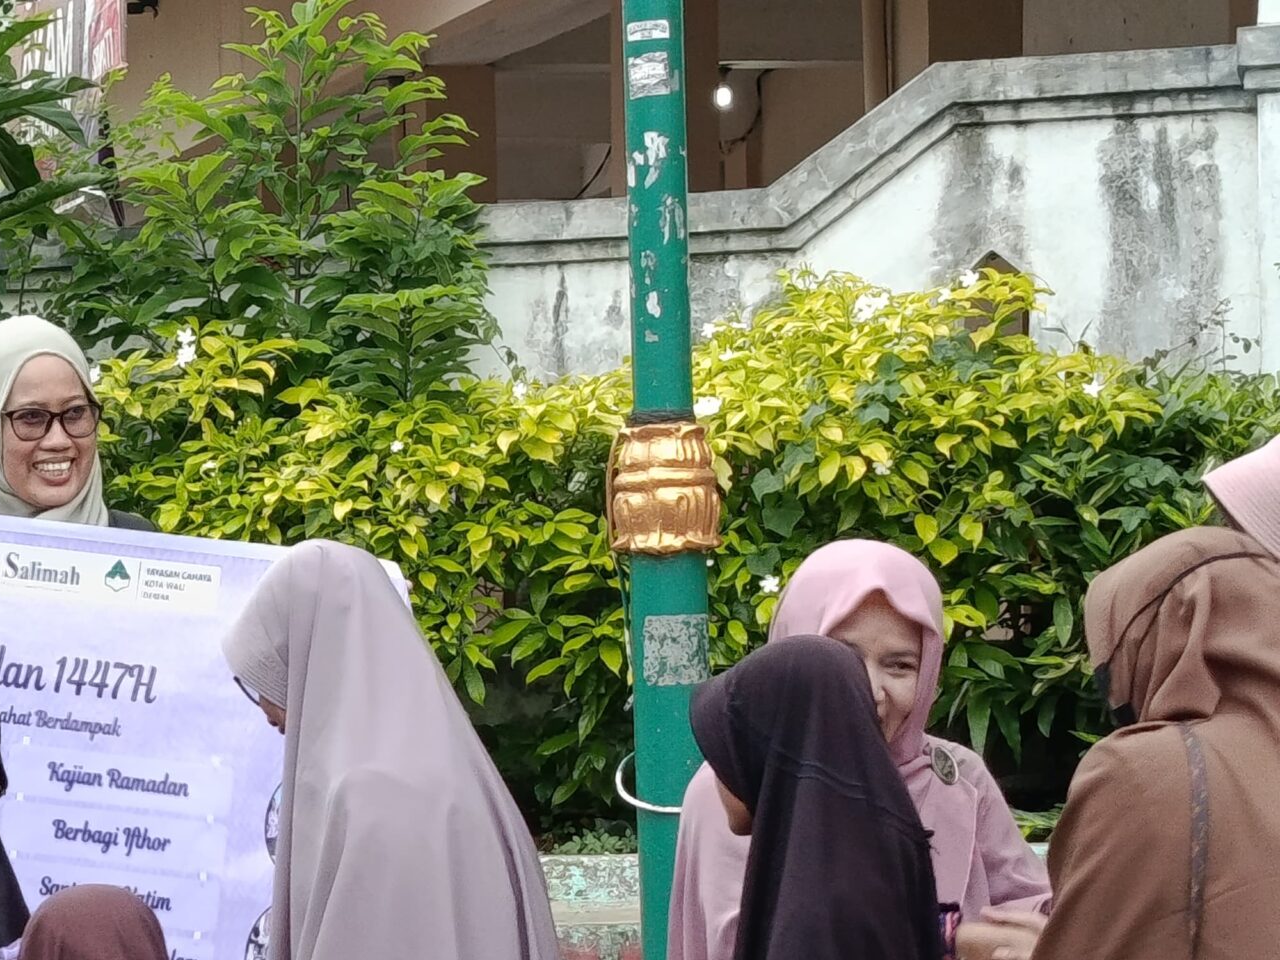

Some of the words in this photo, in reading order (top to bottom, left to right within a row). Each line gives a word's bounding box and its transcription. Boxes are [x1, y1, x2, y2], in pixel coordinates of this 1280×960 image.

[3, 552, 81, 587] Salimah
[54, 656, 157, 704] 1447H
[34, 709, 122, 742] Berdampak
[48, 761, 103, 792] Kajian
[106, 768, 190, 798] Ramadan
[52, 819, 120, 854] Berbagi
[122, 826, 172, 857] Ifthor
